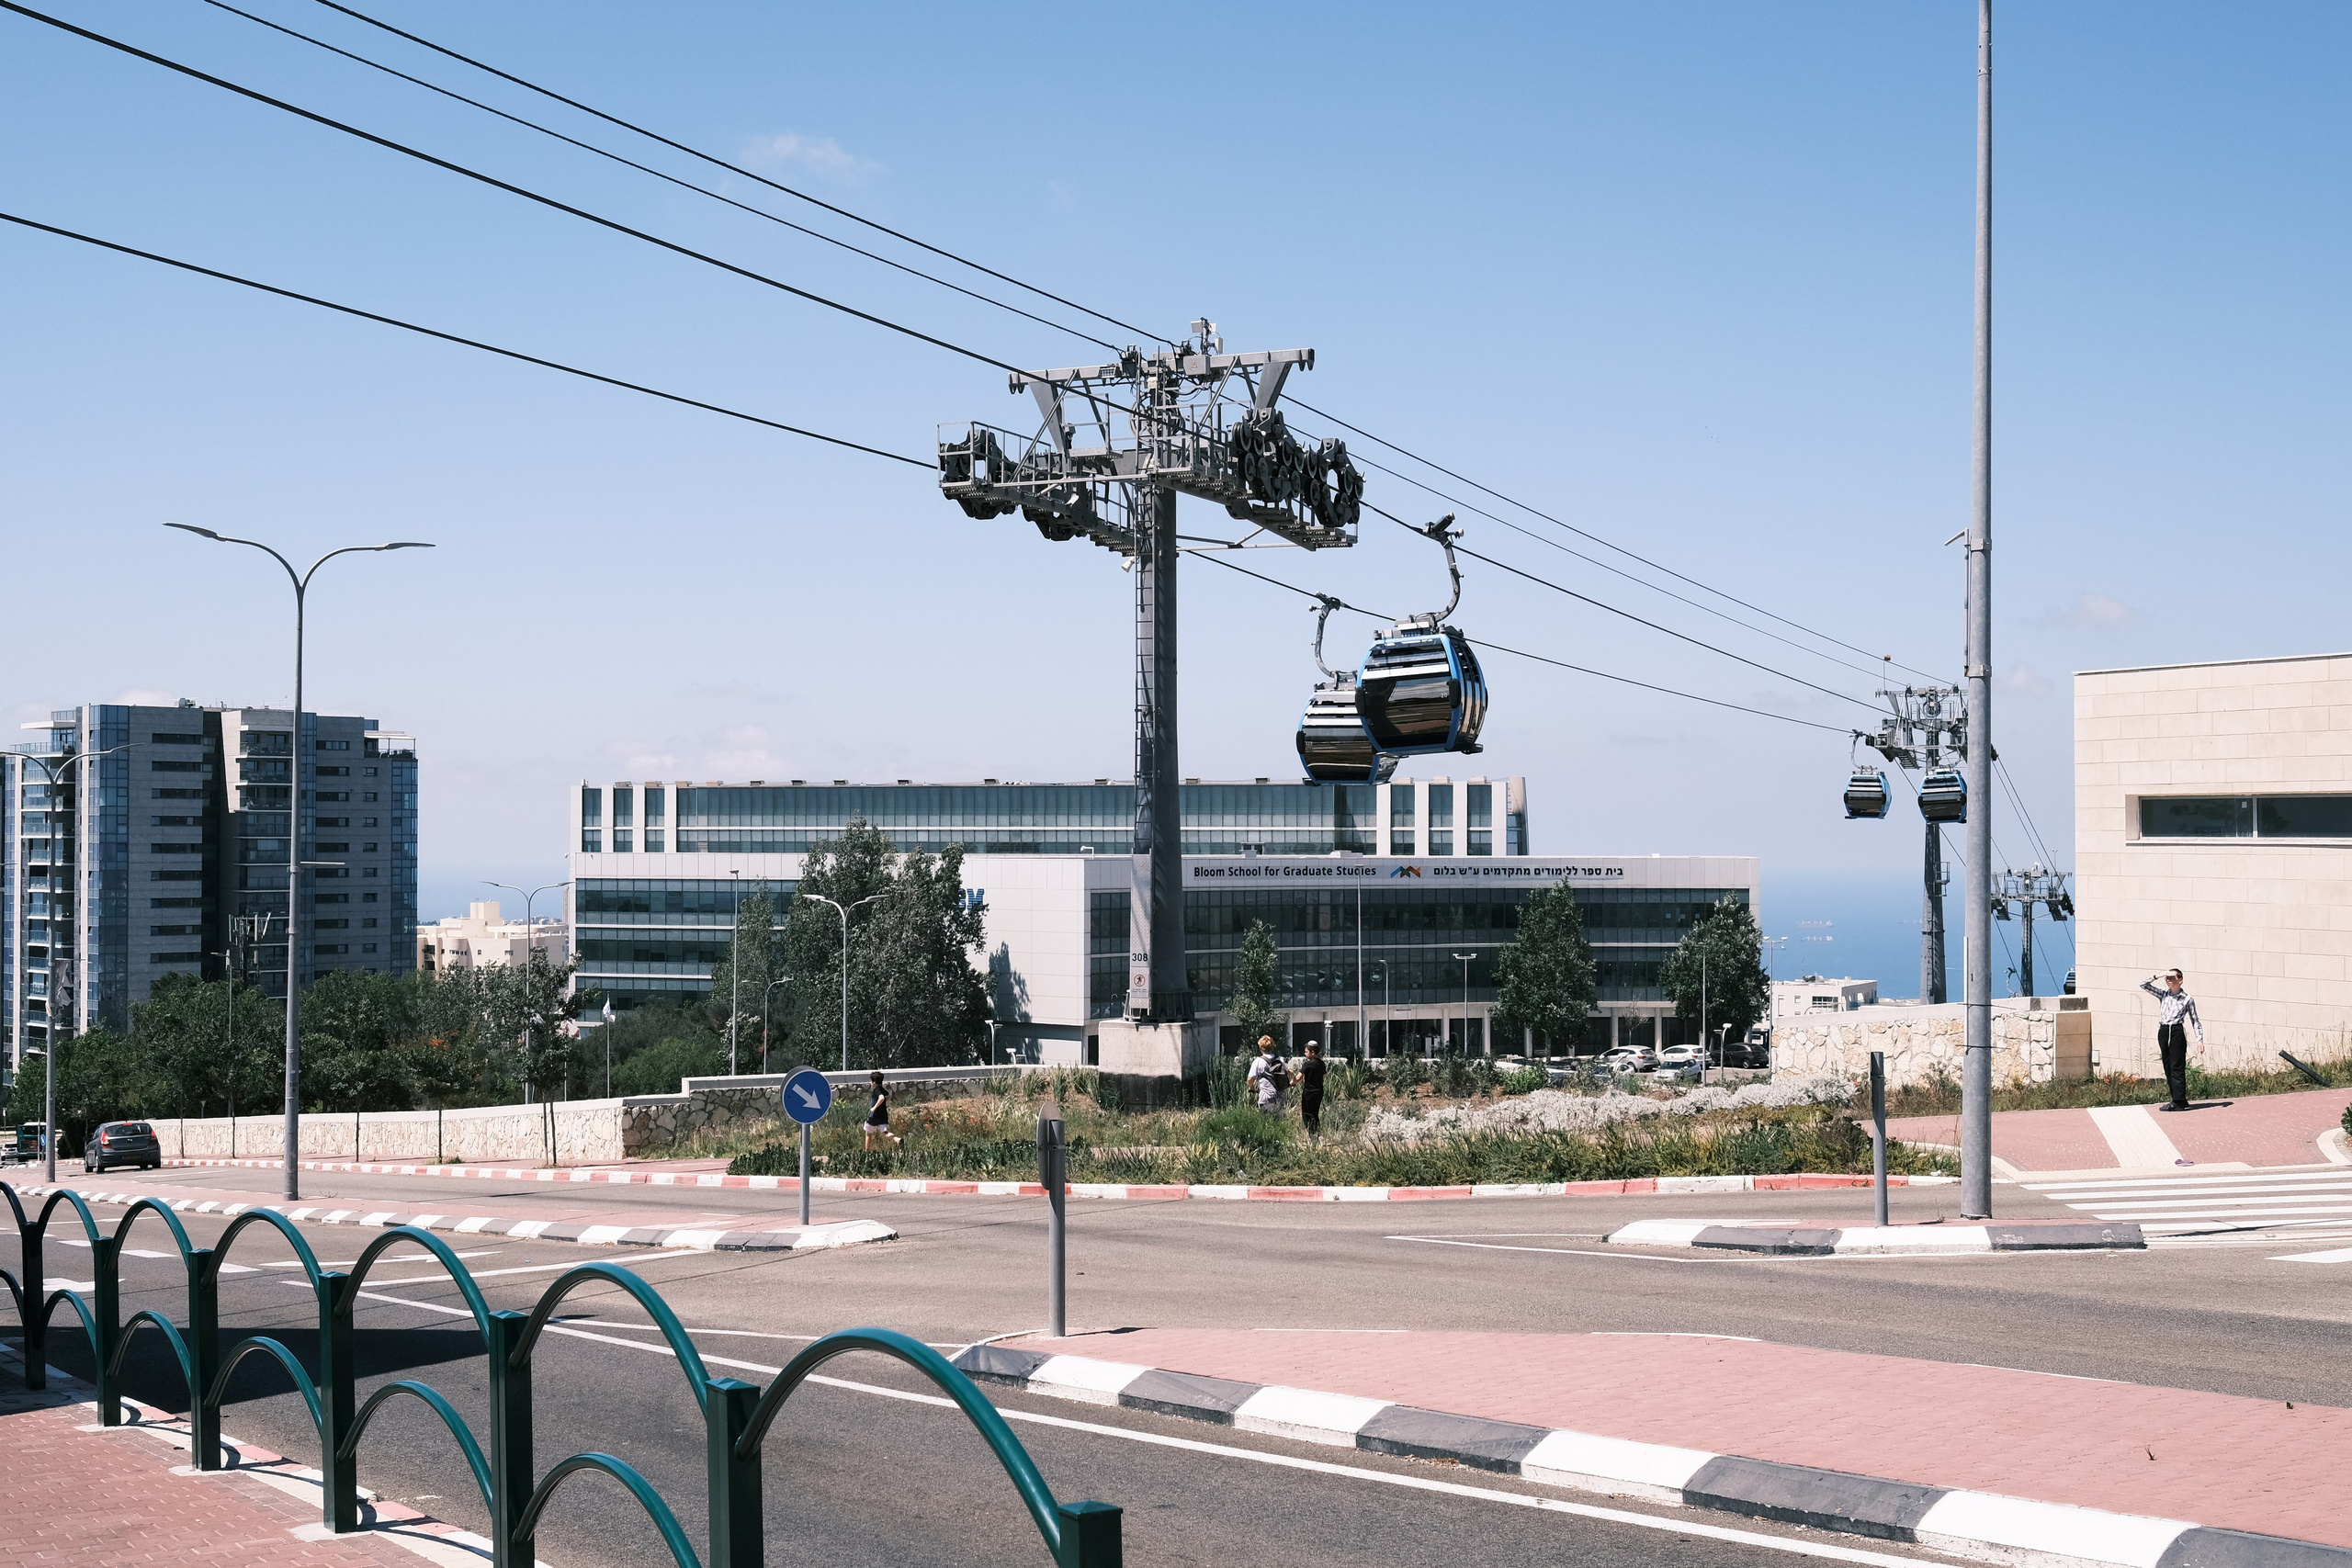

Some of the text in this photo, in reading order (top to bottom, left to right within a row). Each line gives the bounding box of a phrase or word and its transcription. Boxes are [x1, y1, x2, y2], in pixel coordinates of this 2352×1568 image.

[1193, 866, 1226, 877] Bloom
[1227, 865, 1261, 877] School
[1264, 865, 1281, 876] for
[1283, 865, 1333, 876] Graduate
[1433, 865, 1457, 875] בלום
[1482, 867, 1532, 878] מתקדמים
[1533, 865, 1579, 876] ללימודים
[1581, 867, 1602, 876] ספר
[1605, 867, 1623, 875] בית
[1132, 953, 1148, 962] 308
